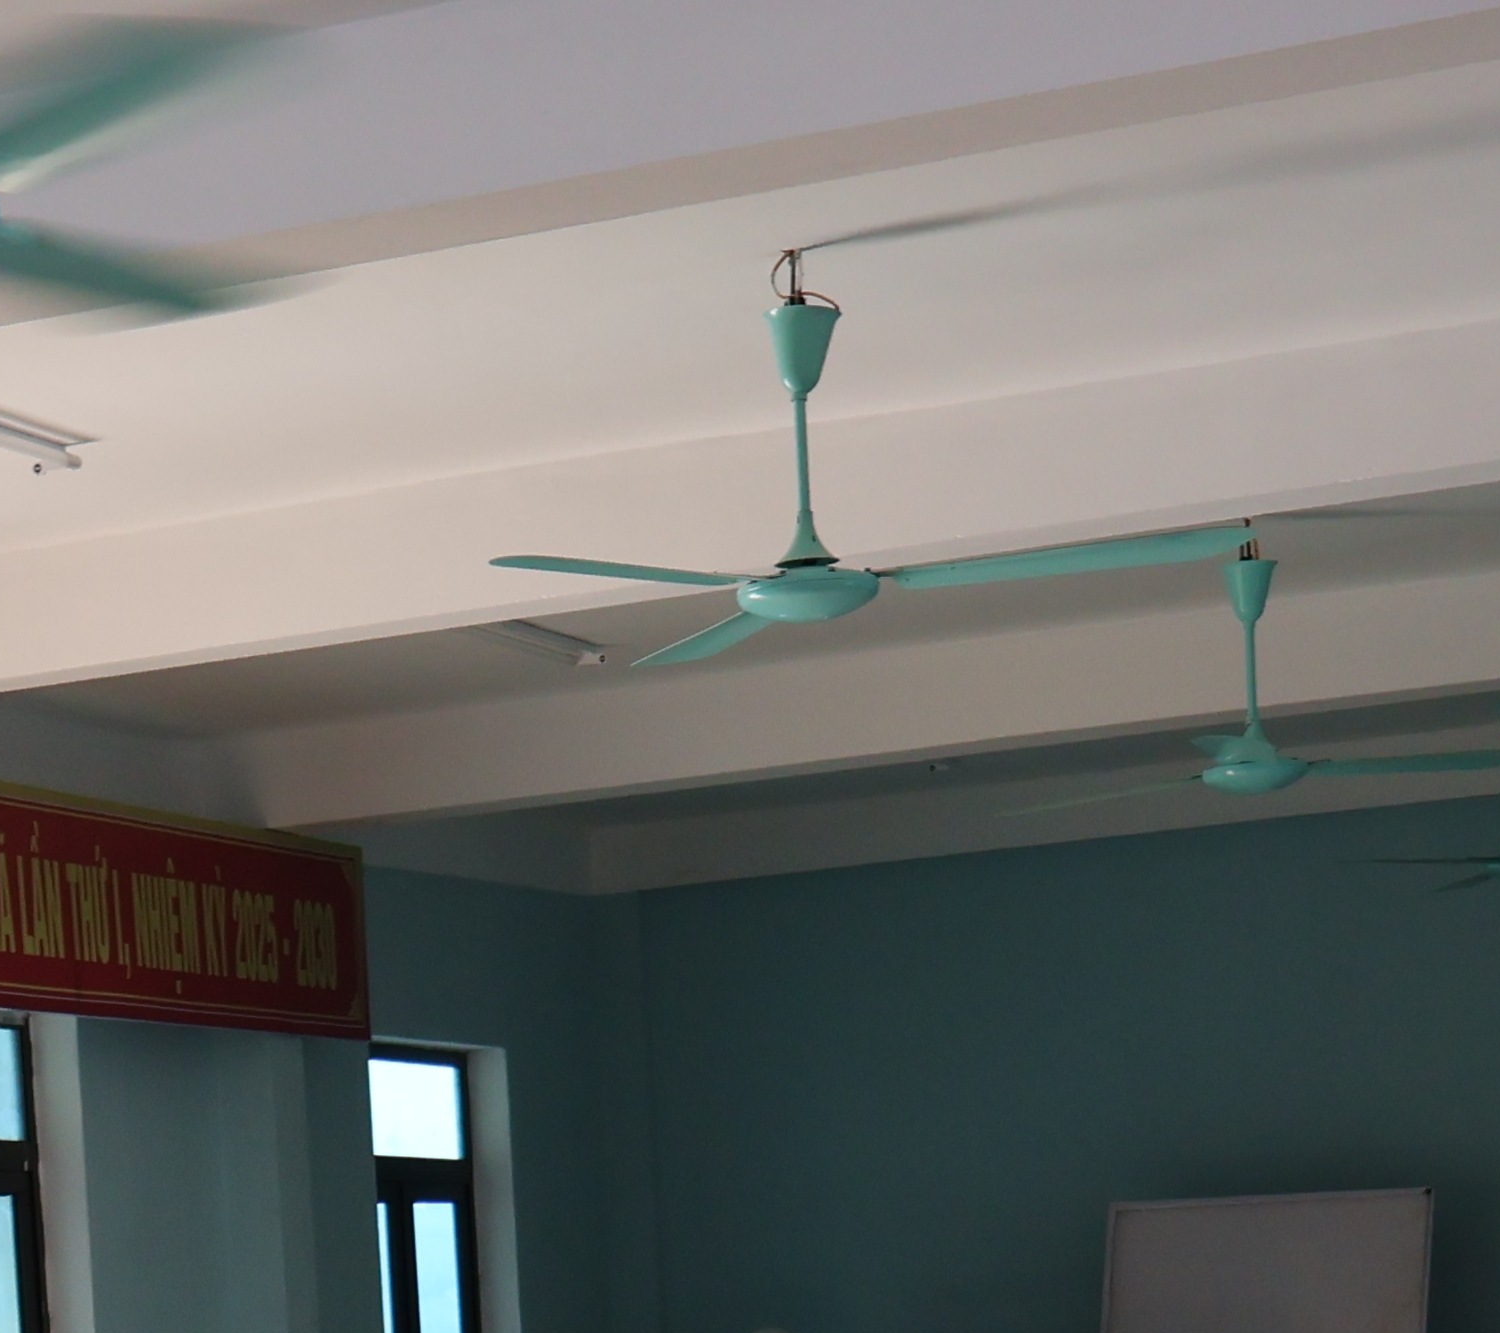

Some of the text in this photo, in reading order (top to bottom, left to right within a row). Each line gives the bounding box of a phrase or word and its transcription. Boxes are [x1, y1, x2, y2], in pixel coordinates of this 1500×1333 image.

[17, 821, 65, 959] LẦN
[65, 845, 110, 964] THỨ
[112, 869, 130, 979] I,
[131, 857, 201, 994] NHIỆM
[202, 865, 228, 977] KỲ
[232, 888, 279, 983] 2025
[293, 899, 337, 991] 2030
